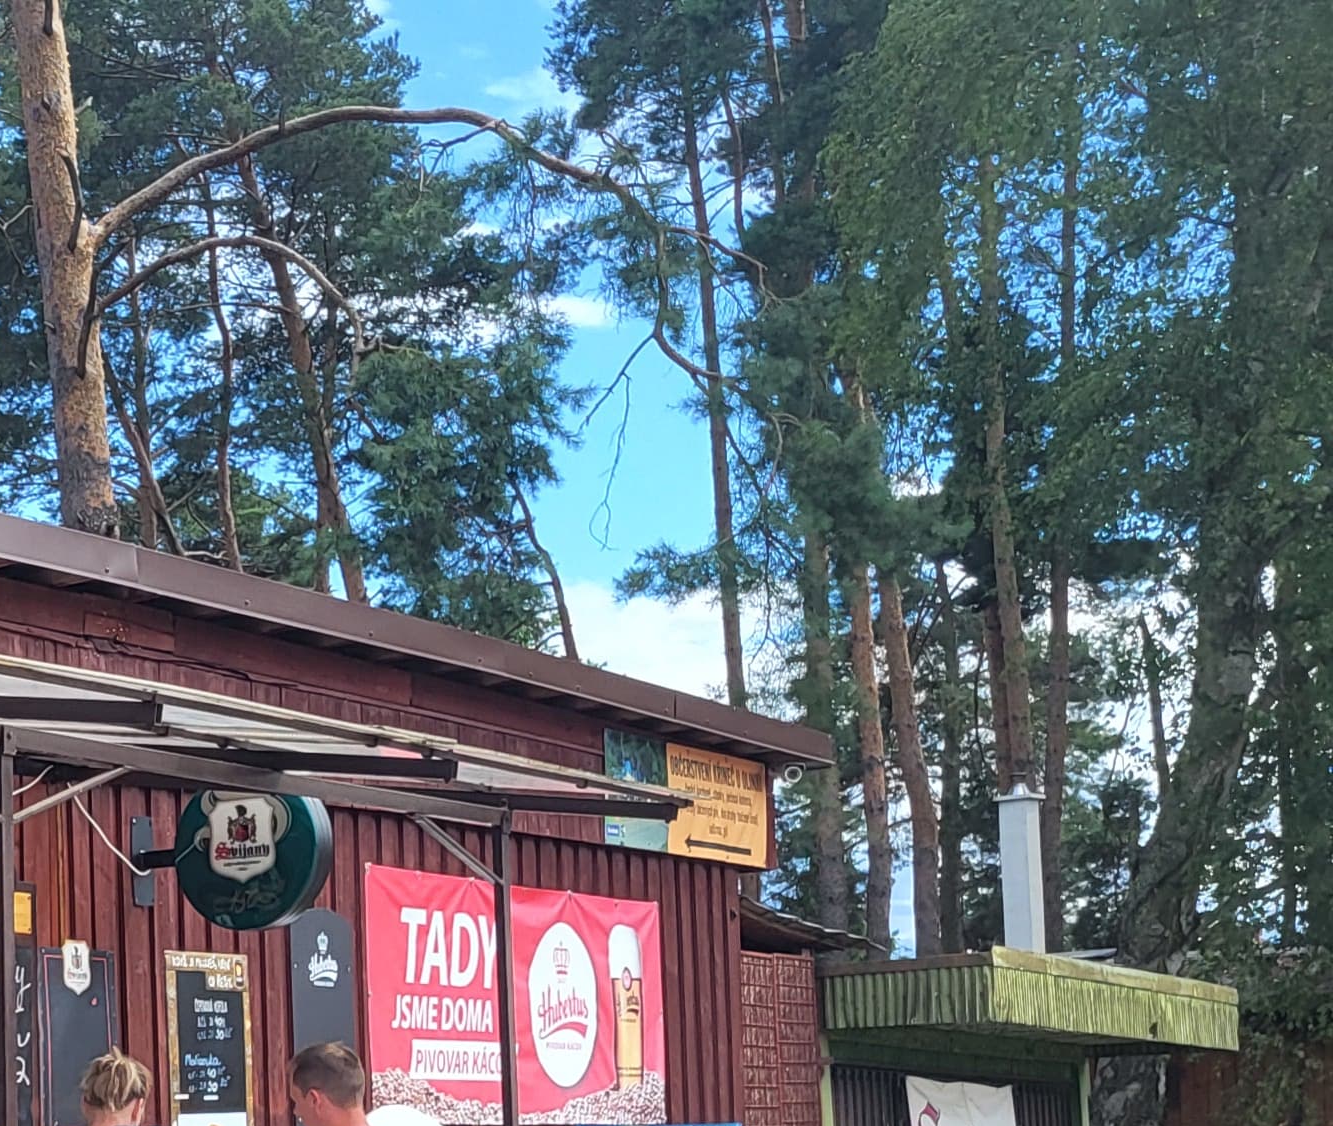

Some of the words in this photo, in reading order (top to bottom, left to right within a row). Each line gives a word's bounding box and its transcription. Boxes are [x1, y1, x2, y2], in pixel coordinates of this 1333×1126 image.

[400, 906, 497, 990] TADY
[391, 994, 438, 1030] JSME
[441, 997, 494, 1033] DOMA
[538, 984, 589, 1035] Hubertus
[415, 1049, 469, 1074] PIVOVAR
